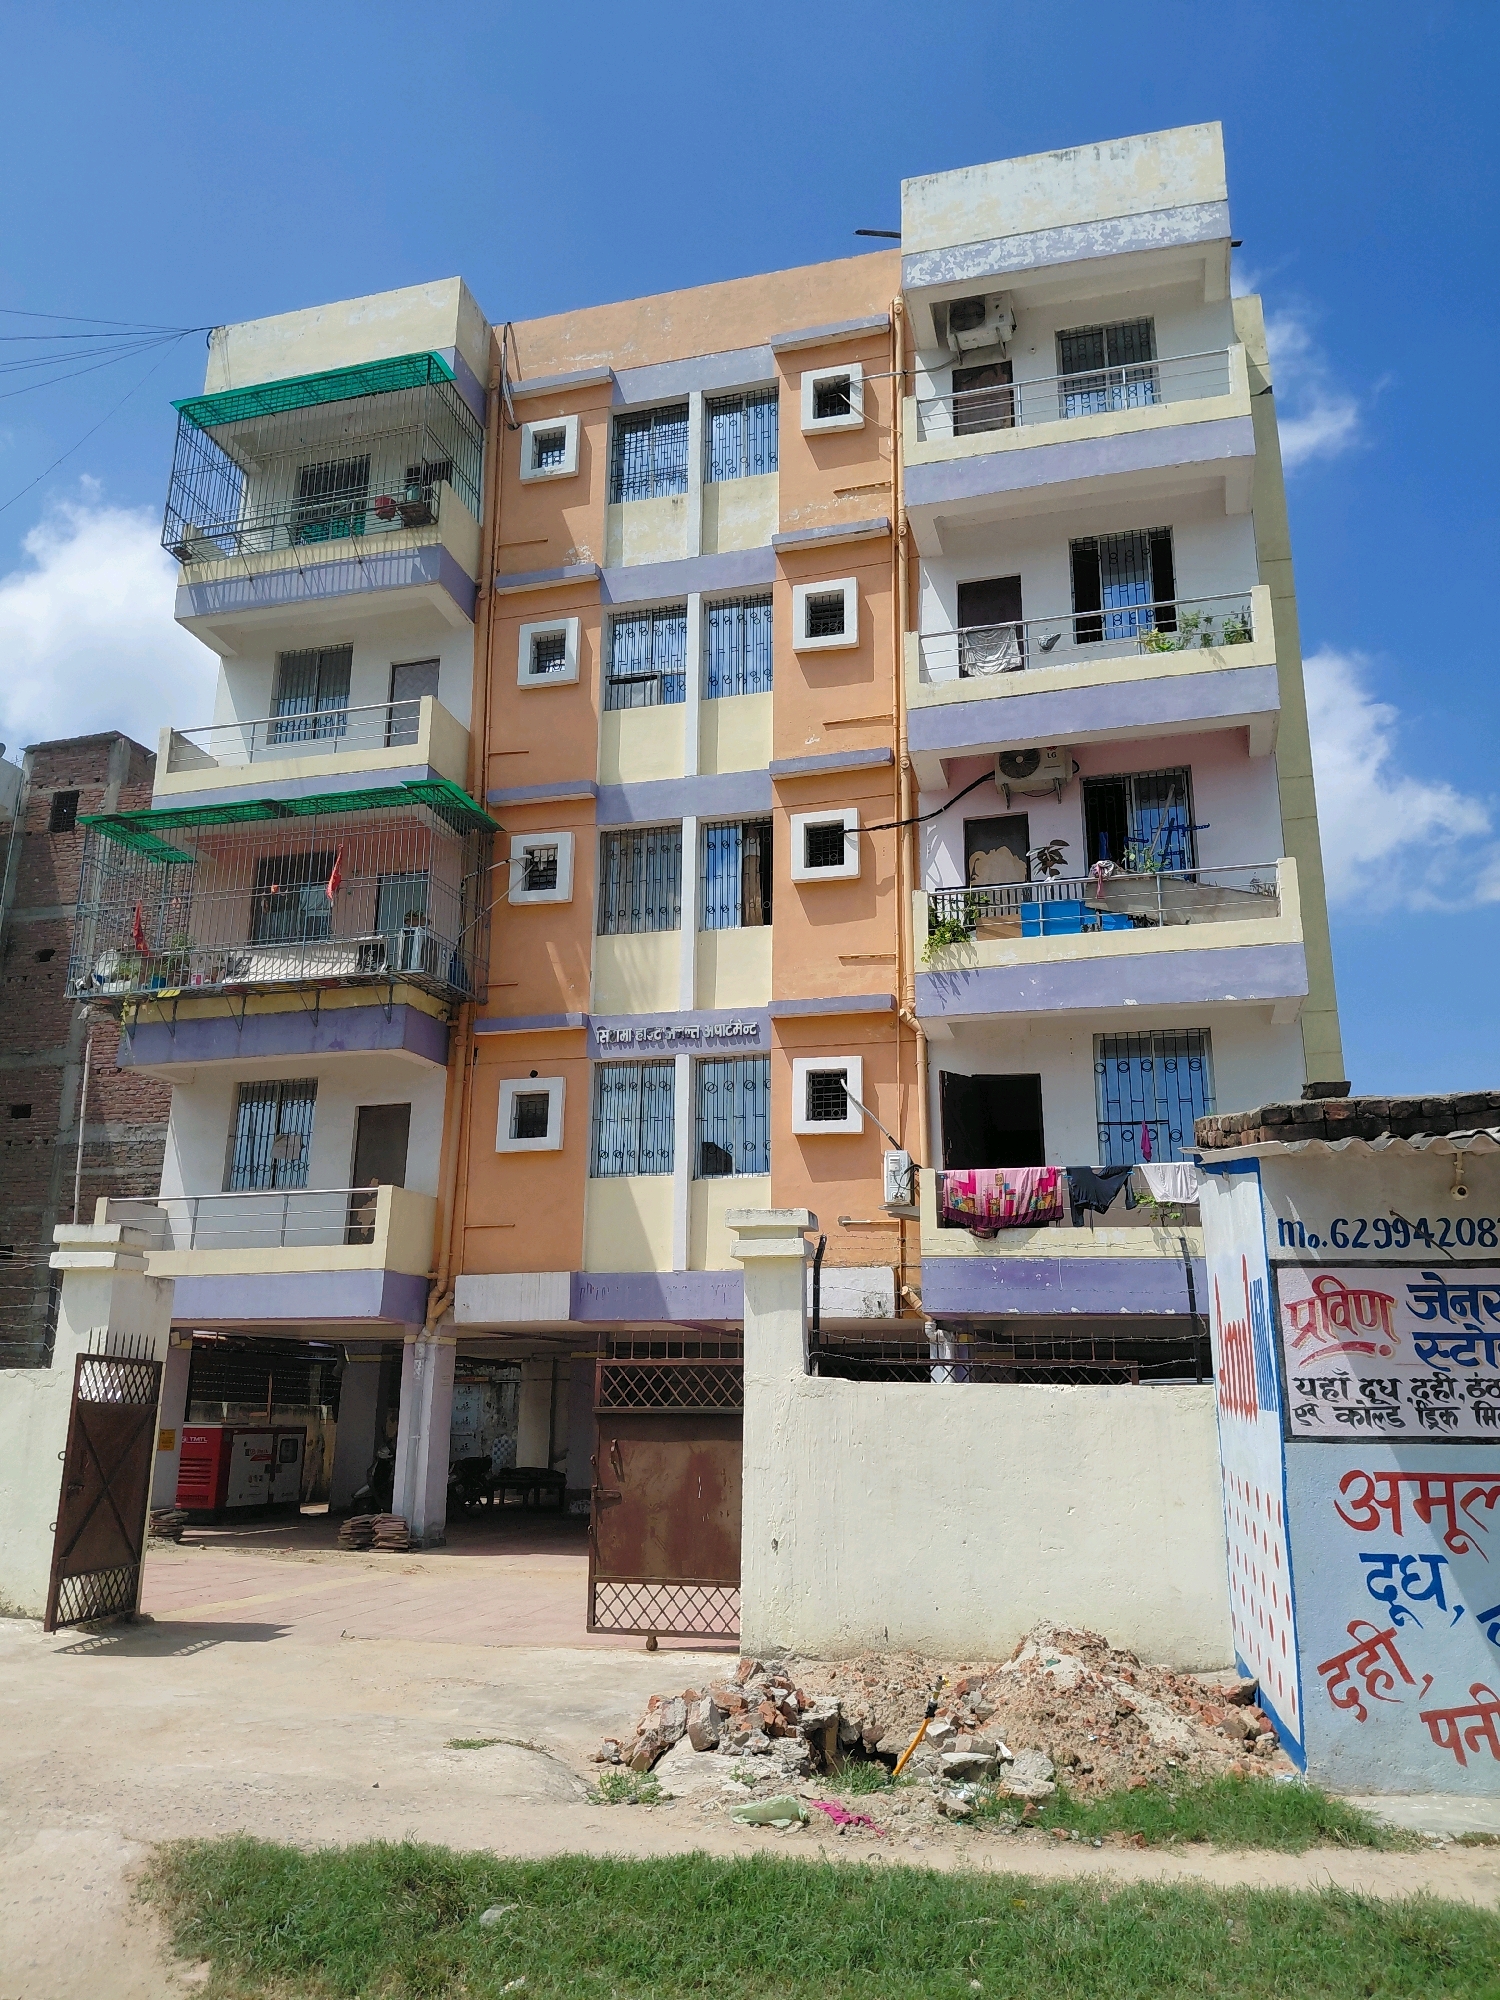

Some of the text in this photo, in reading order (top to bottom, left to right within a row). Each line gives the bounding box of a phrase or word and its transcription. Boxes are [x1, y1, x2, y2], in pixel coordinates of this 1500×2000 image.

[1047, 751, 1057, 759] LG
[1284, 1274, 1398, 1350] प्रविण
[1411, 1323, 1500, 1373] स्टो
[1332, 1399, 1406, 1431] कोल्ड
[1469, 1399, 1500, 1430] मि
